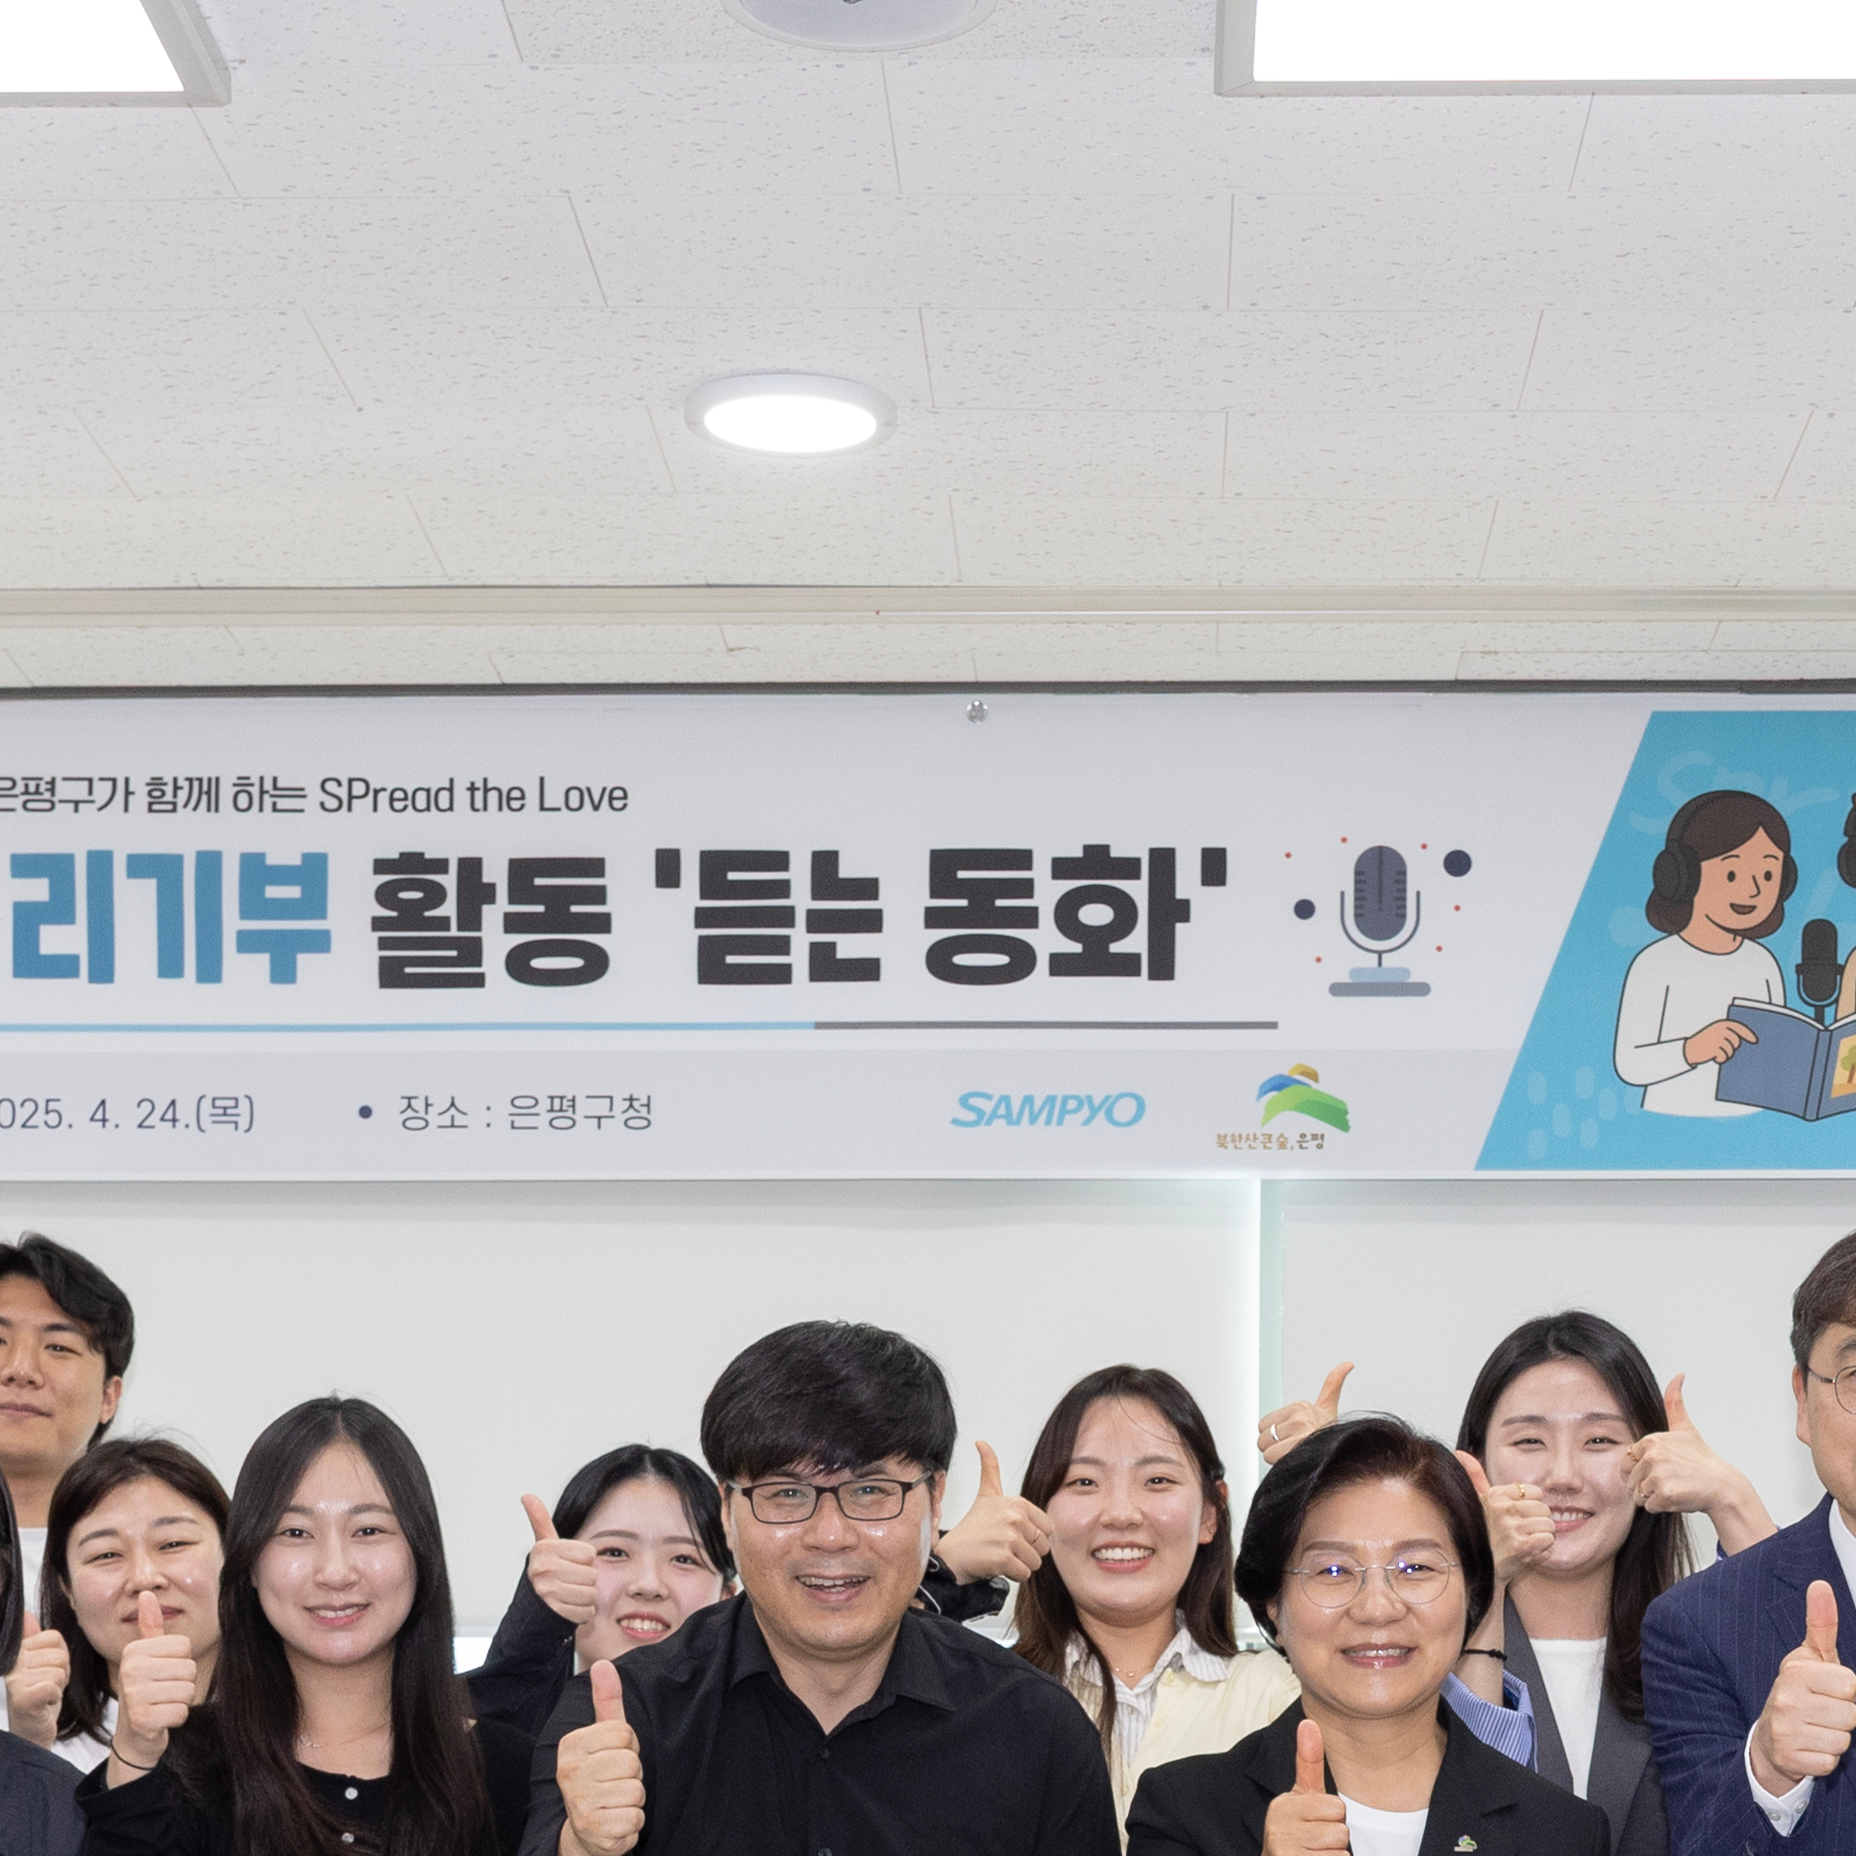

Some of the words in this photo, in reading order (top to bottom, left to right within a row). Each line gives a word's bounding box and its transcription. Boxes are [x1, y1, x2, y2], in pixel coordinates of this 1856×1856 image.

[145, 775, 221, 814] 함께
[231, 775, 308, 814] 하는
[319, 776, 455, 814] SPread
[465, 776, 527, 813] the
[538, 775, 629, 813] Love
[369, 850, 613, 990] 활동
[89, 1098, 120, 1129] 4.
[136, 1094, 254, 1134] 24.(목)
[399, 1095, 469, 1132] 장소
[508, 1093, 652, 1131] 은평구청
[949, 1090, 1147, 1129] SAMPYO
